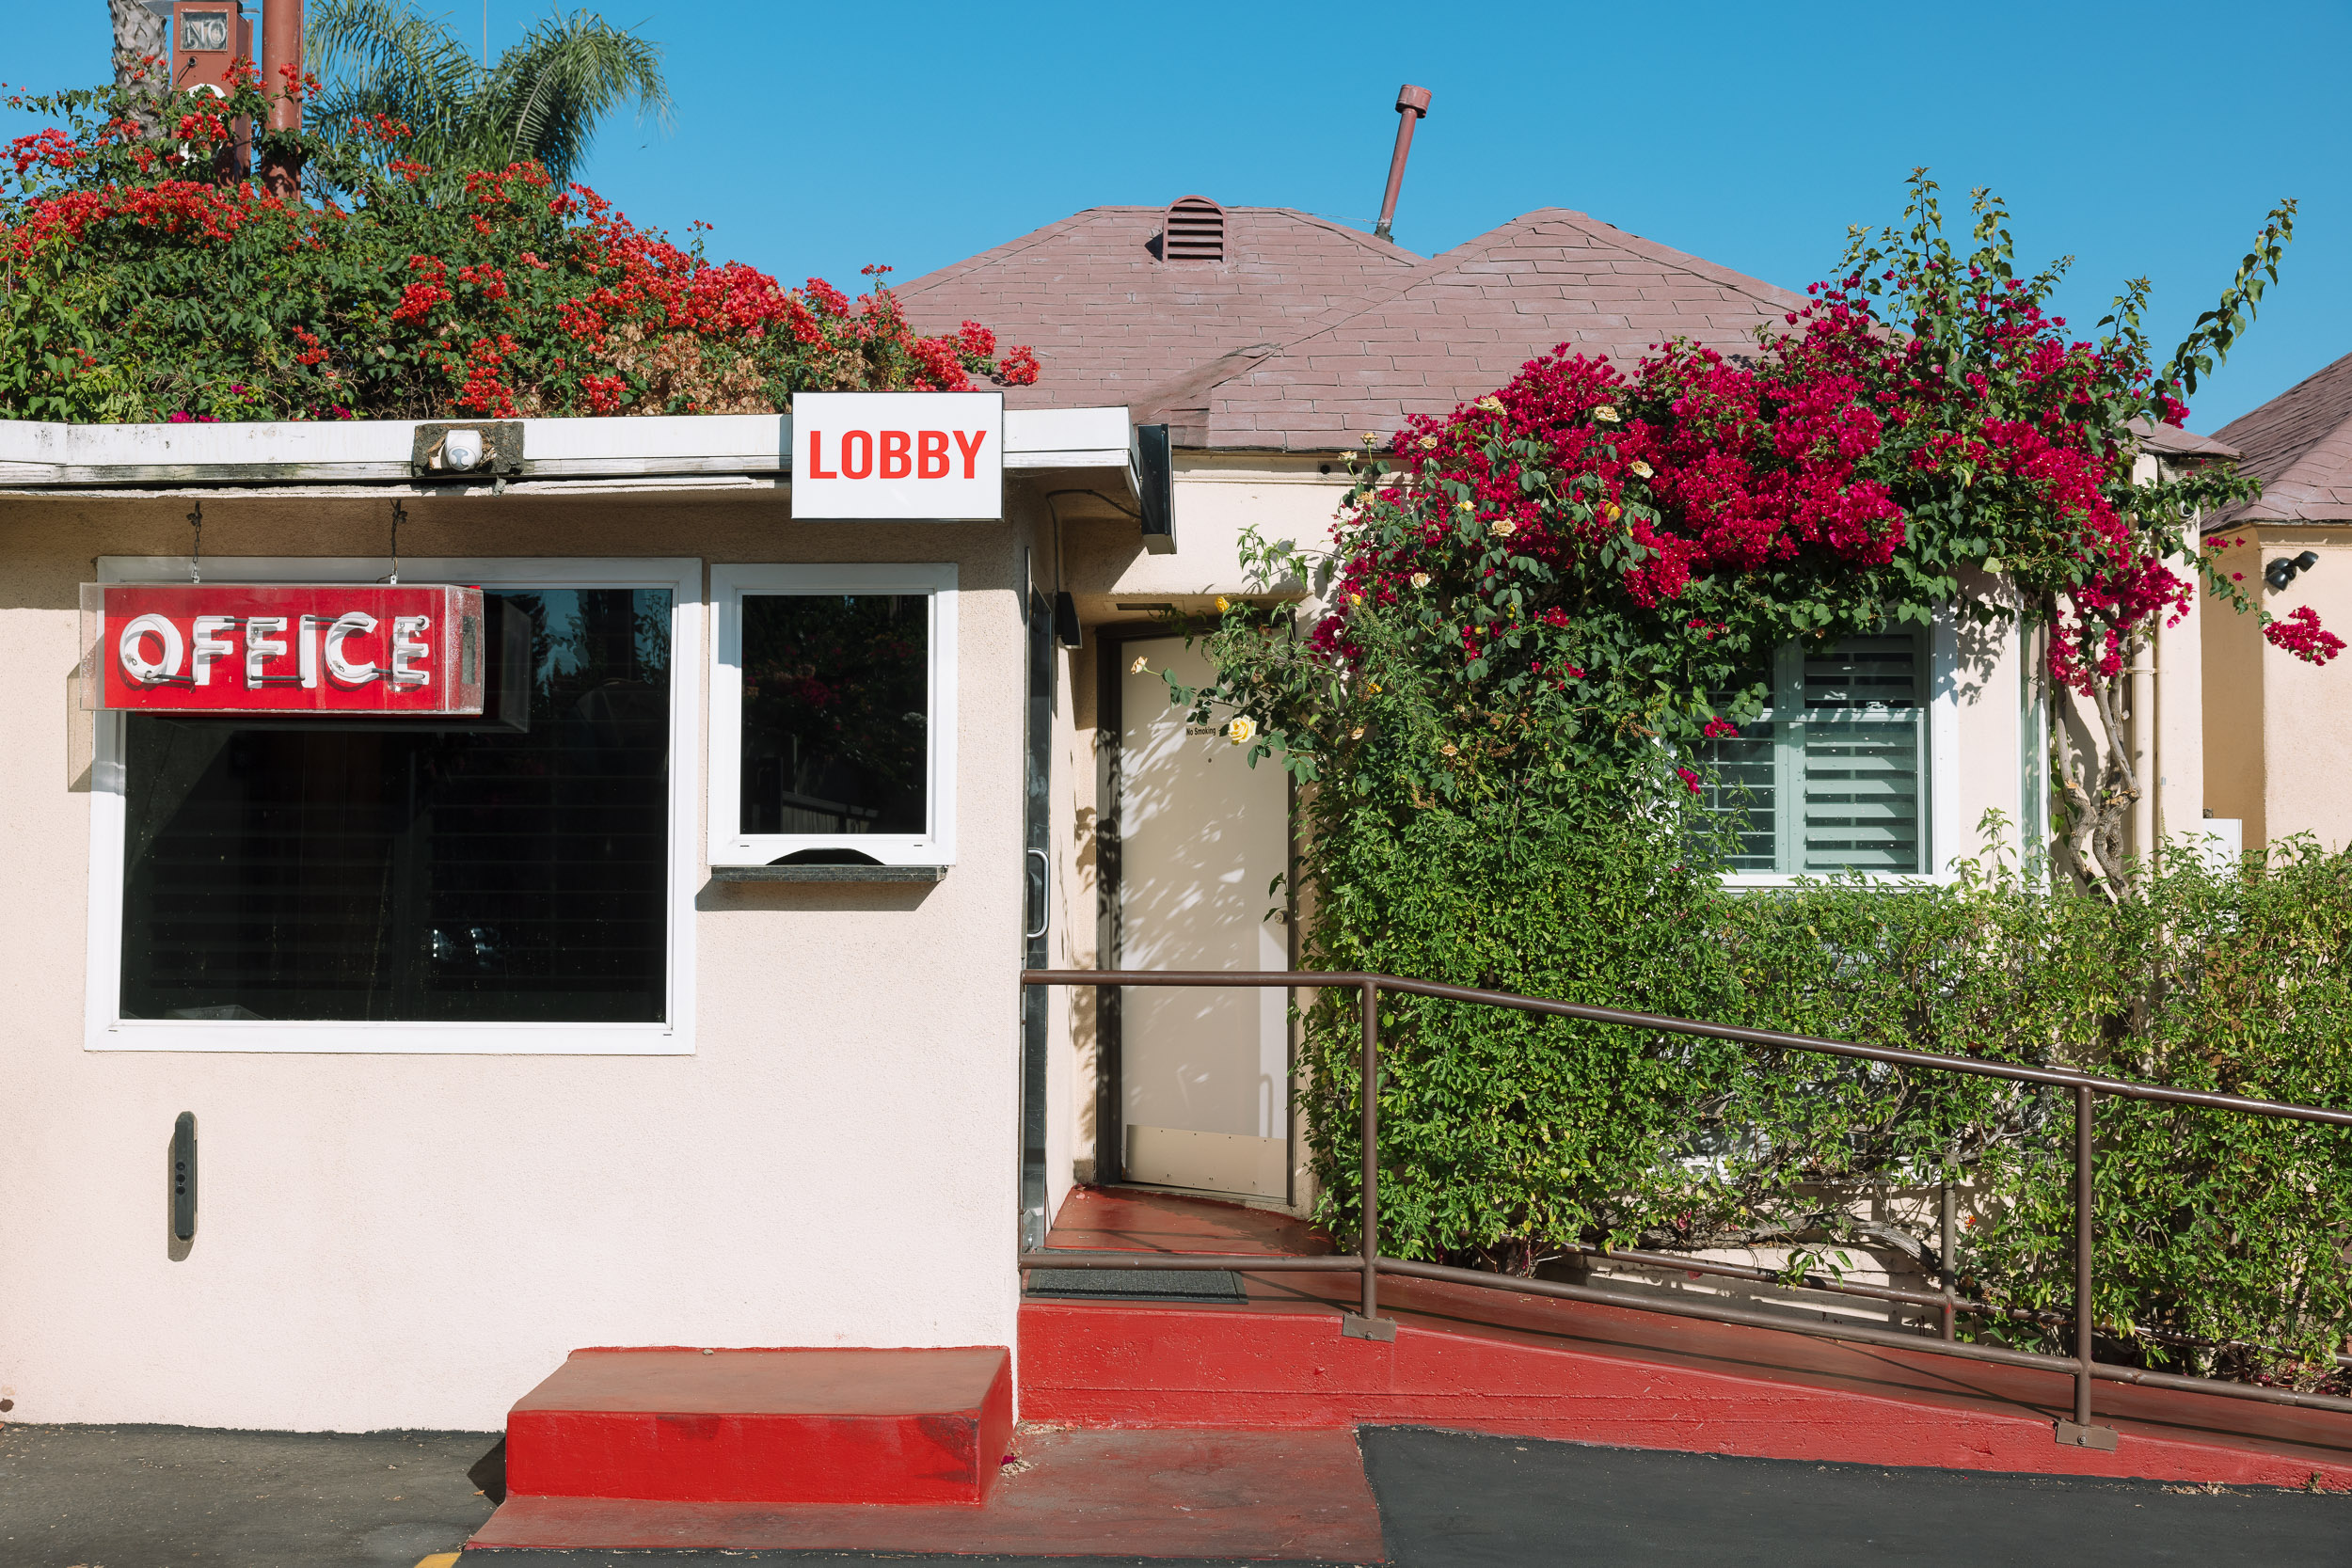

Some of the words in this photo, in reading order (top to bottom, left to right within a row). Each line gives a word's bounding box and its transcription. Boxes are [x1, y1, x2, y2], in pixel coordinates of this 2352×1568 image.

[186, 20, 226, 45] NO
[809, 429, 987, 480] LOBBY
[119, 611, 430, 689] OFFICE
[1194, 727, 1216, 736] Smoking
